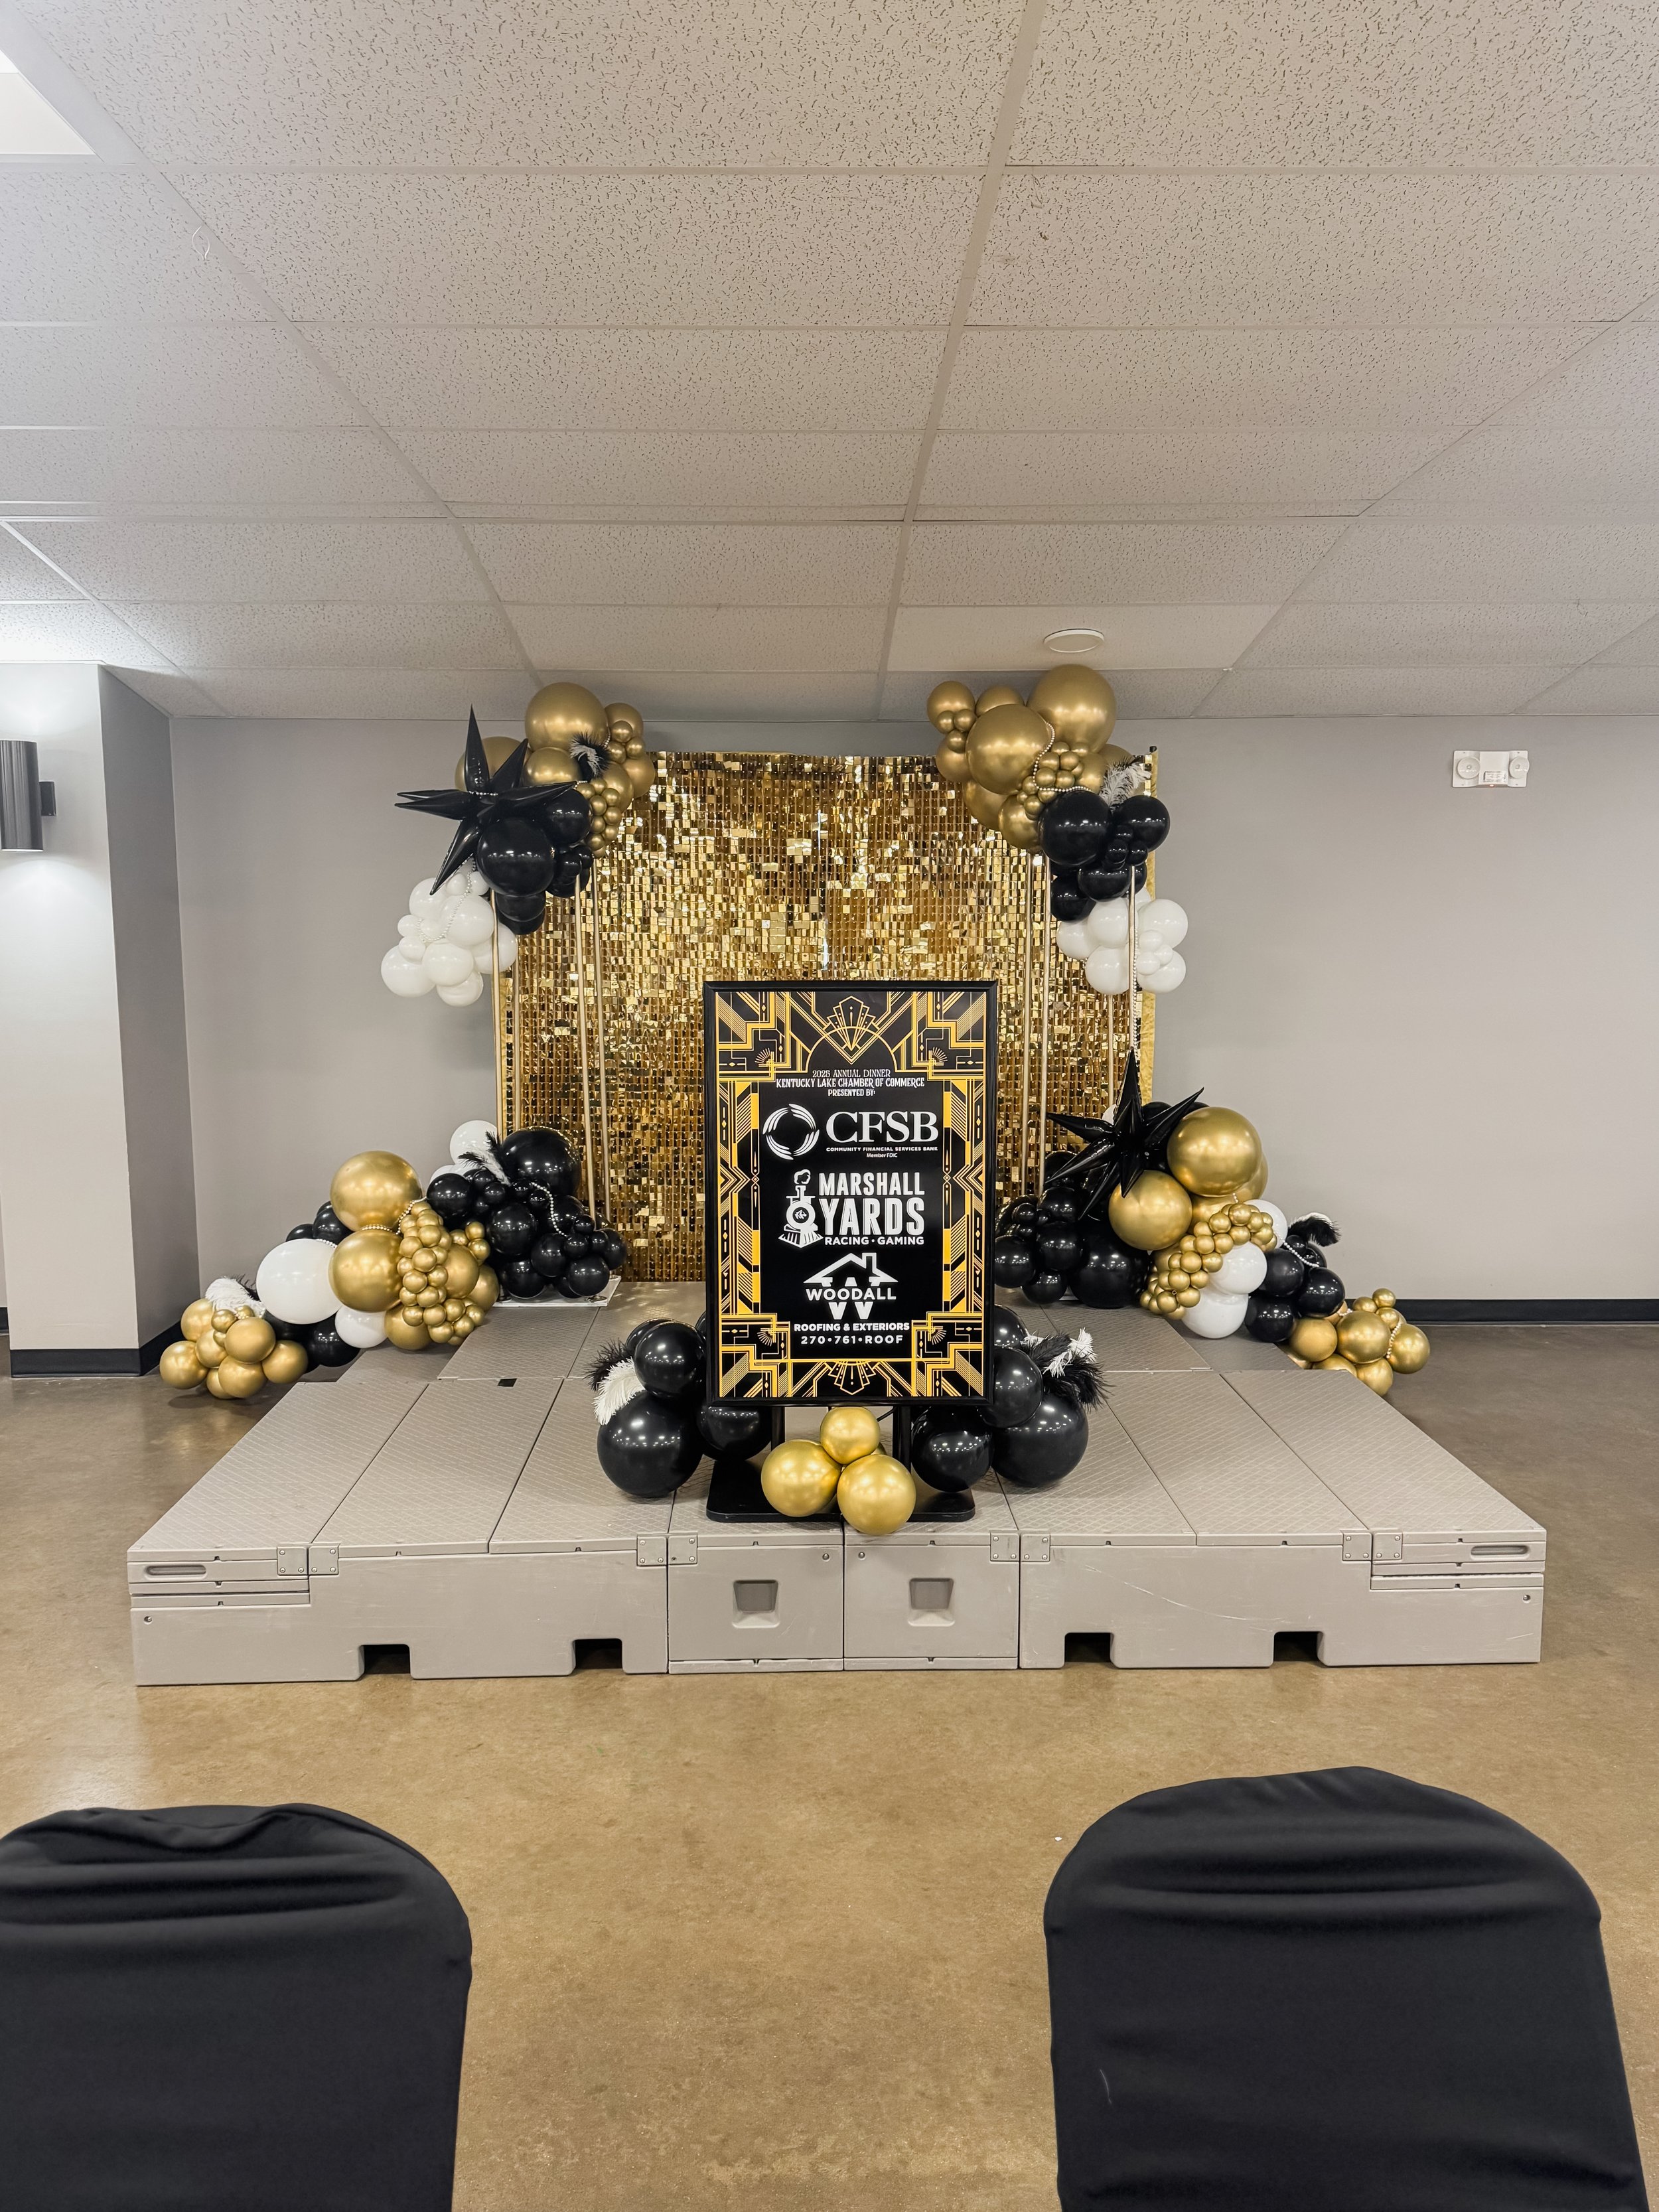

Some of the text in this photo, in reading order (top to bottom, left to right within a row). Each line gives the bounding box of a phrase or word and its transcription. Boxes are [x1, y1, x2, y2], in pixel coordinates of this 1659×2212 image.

[833, 1069, 861, 1078] ANNUAL
[863, 1069, 891, 1078] DINNER
[776, 1077, 924, 1088] KENTUCKY LAKE CHAMBER OF COMMERCE
[826, 1111, 938, 1143] CFSB
[819, 1172, 925, 1196] MARSHALL
[818, 1197, 925, 1236] YARDS
[825, 1236, 924, 1245] RACING GAMING
[806, 1288, 897, 1301] WOODALL
[843, 1323, 850, 1331] &
